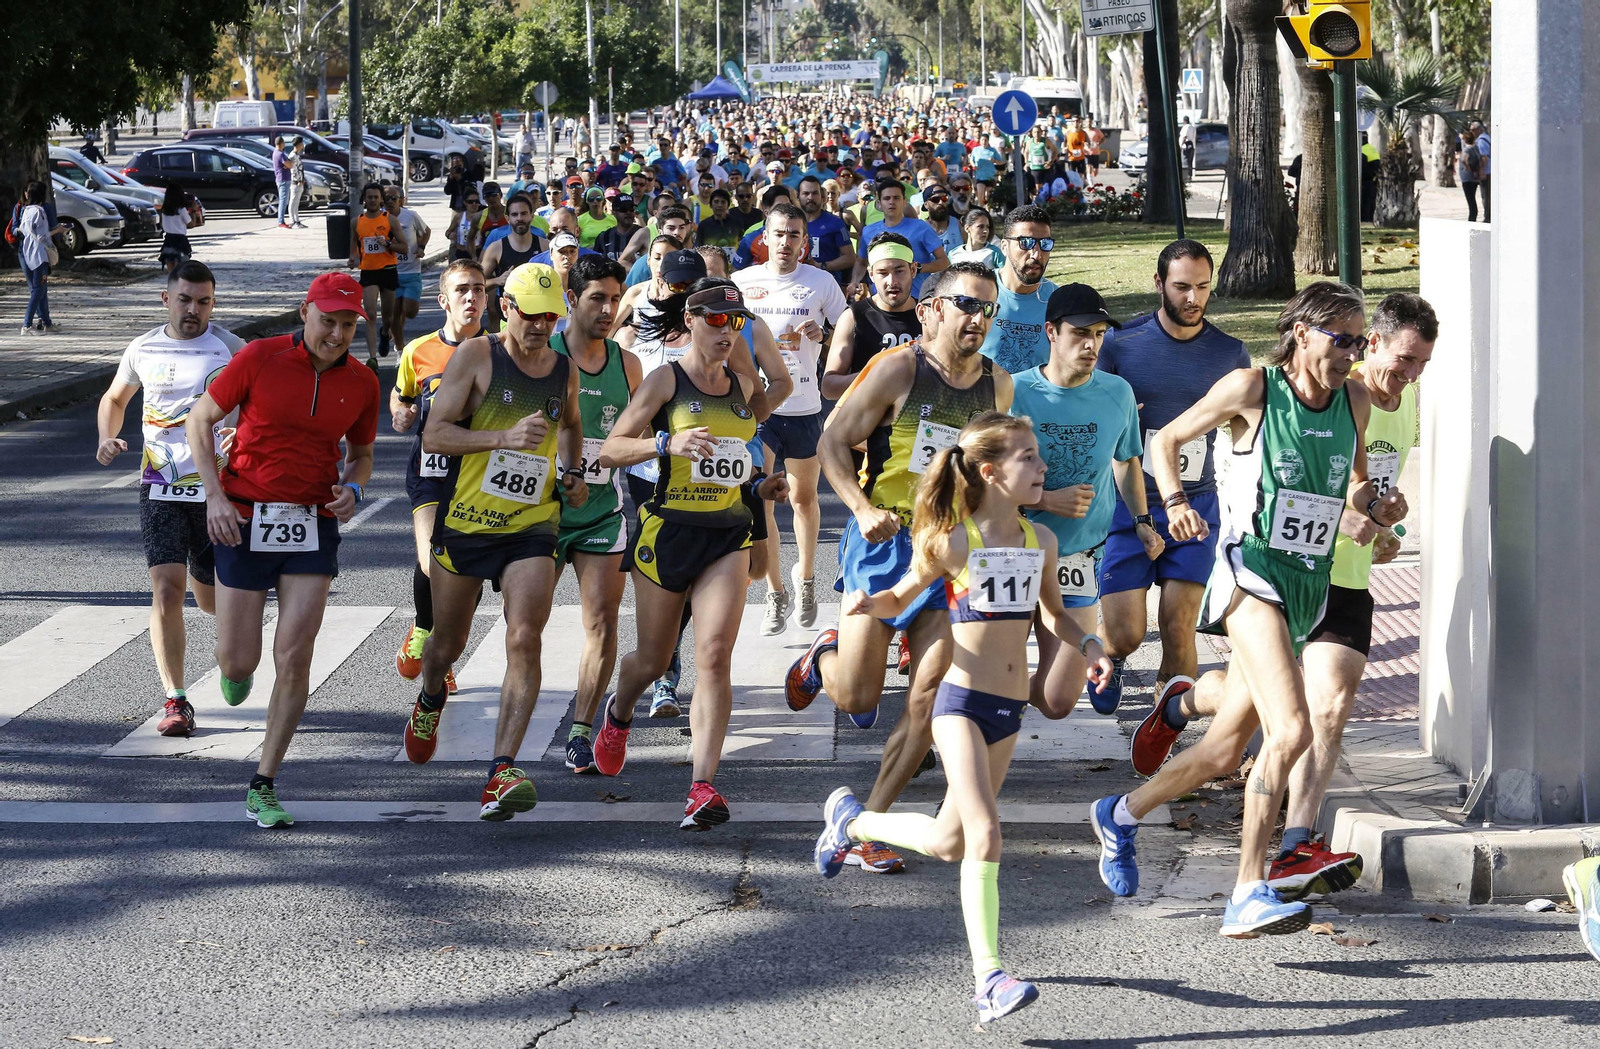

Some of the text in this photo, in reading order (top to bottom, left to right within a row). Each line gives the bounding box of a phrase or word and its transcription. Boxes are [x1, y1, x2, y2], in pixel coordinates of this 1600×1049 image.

[770, 65, 802, 73] CARRERA
[803, 64, 812, 72] DE
[824, 63, 851, 71] PRENSA
[368, 243, 379, 251] 88
[753, 306, 810, 316] MEDIA MARATÓN
[927, 424, 950, 435] CARRERA
[499, 450, 521, 459] CARRERA
[699, 458, 744, 479] 660
[490, 470, 538, 496] 488
[1288, 493, 1313, 503] CARRERA
[456, 502, 465, 510] C.
[467, 505, 478, 514] A.
[451, 510, 510, 528] DE LA MIEL
[259, 523, 307, 543] 739
[1281, 516, 1329, 545] 512
[1057, 565, 1085, 587] 60
[981, 576, 1032, 602] 111
